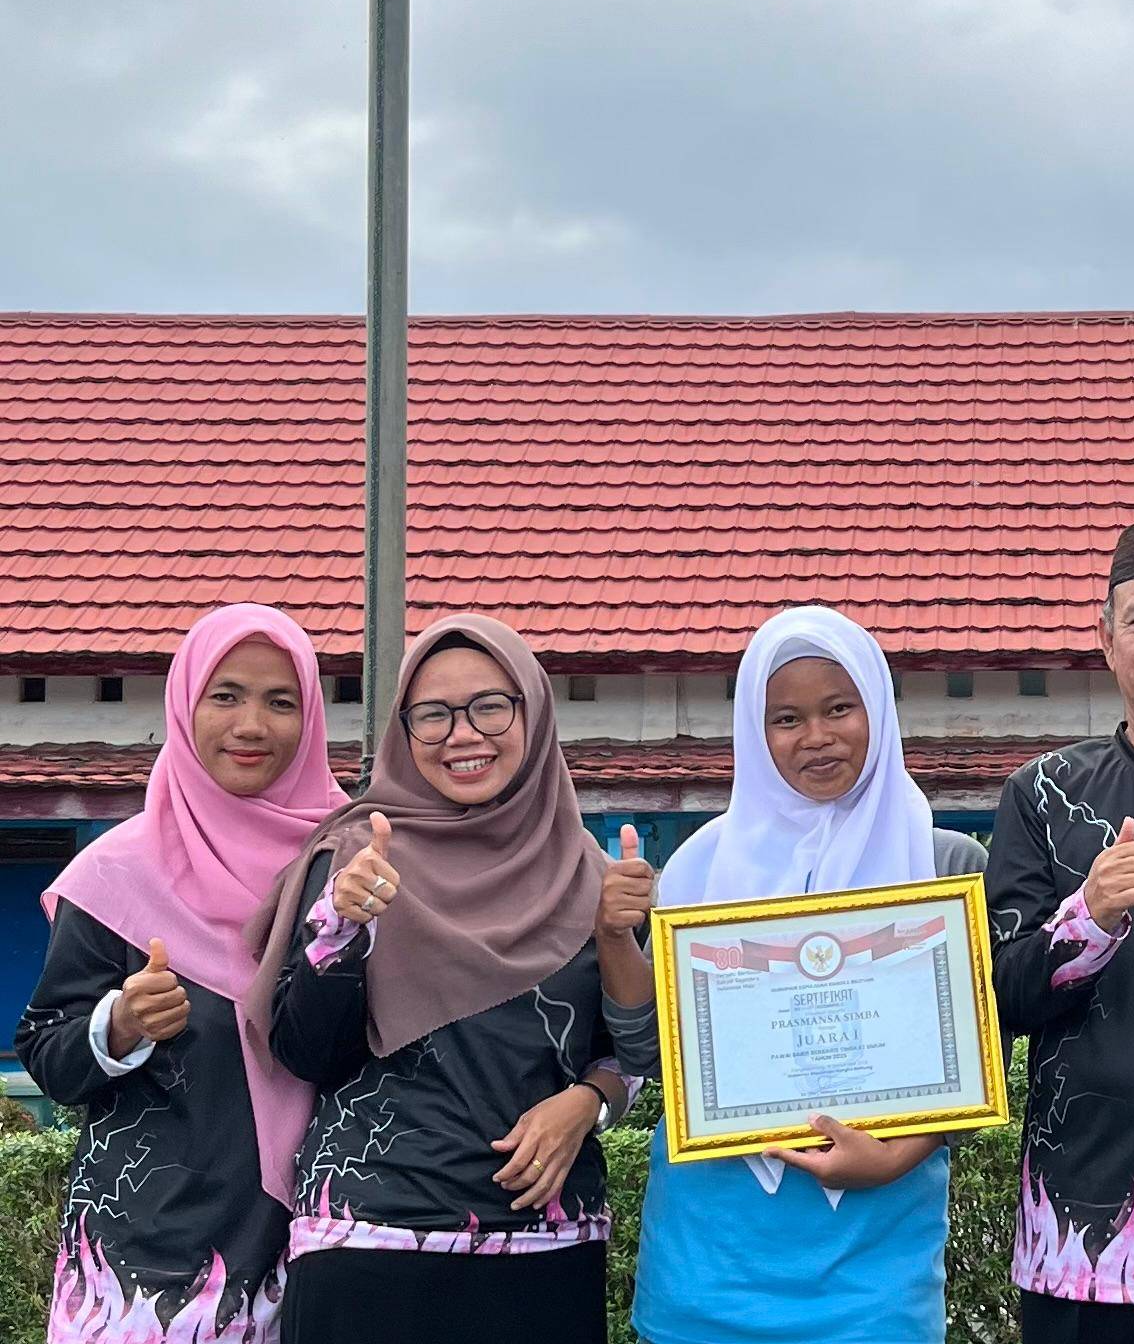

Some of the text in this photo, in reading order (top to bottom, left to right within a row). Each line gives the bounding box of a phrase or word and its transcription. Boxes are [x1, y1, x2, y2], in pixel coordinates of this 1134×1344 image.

[794, 989, 853, 1006] SERTIFIKAT
[771, 1015, 841, 1029] PRASMANSA
[844, 1010, 880, 1022] SIMBA
[797, 1031, 849, 1047] JUARA
